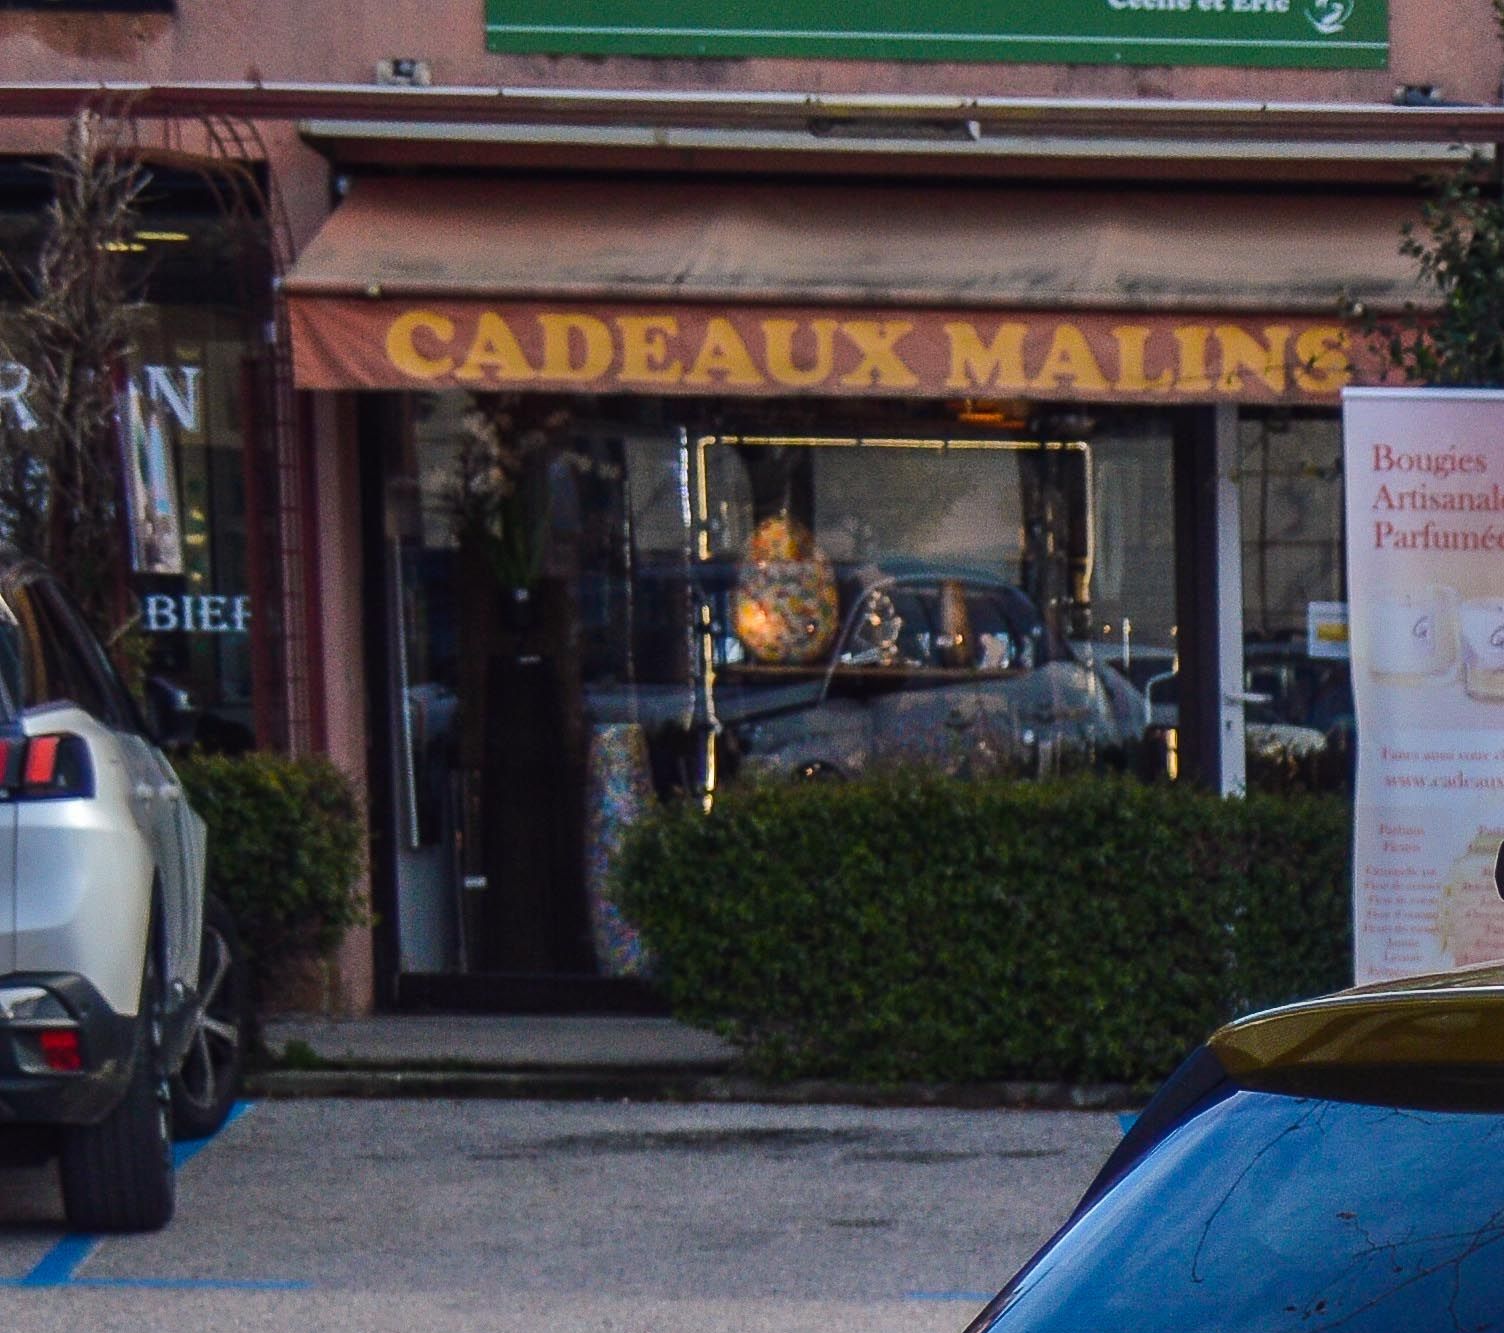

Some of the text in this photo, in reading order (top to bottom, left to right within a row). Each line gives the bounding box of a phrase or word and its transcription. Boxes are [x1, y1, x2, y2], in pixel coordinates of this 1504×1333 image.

[386, 310, 1354, 395] CADEAUX MALINS
[1373, 443, 1489, 479] Bougies
